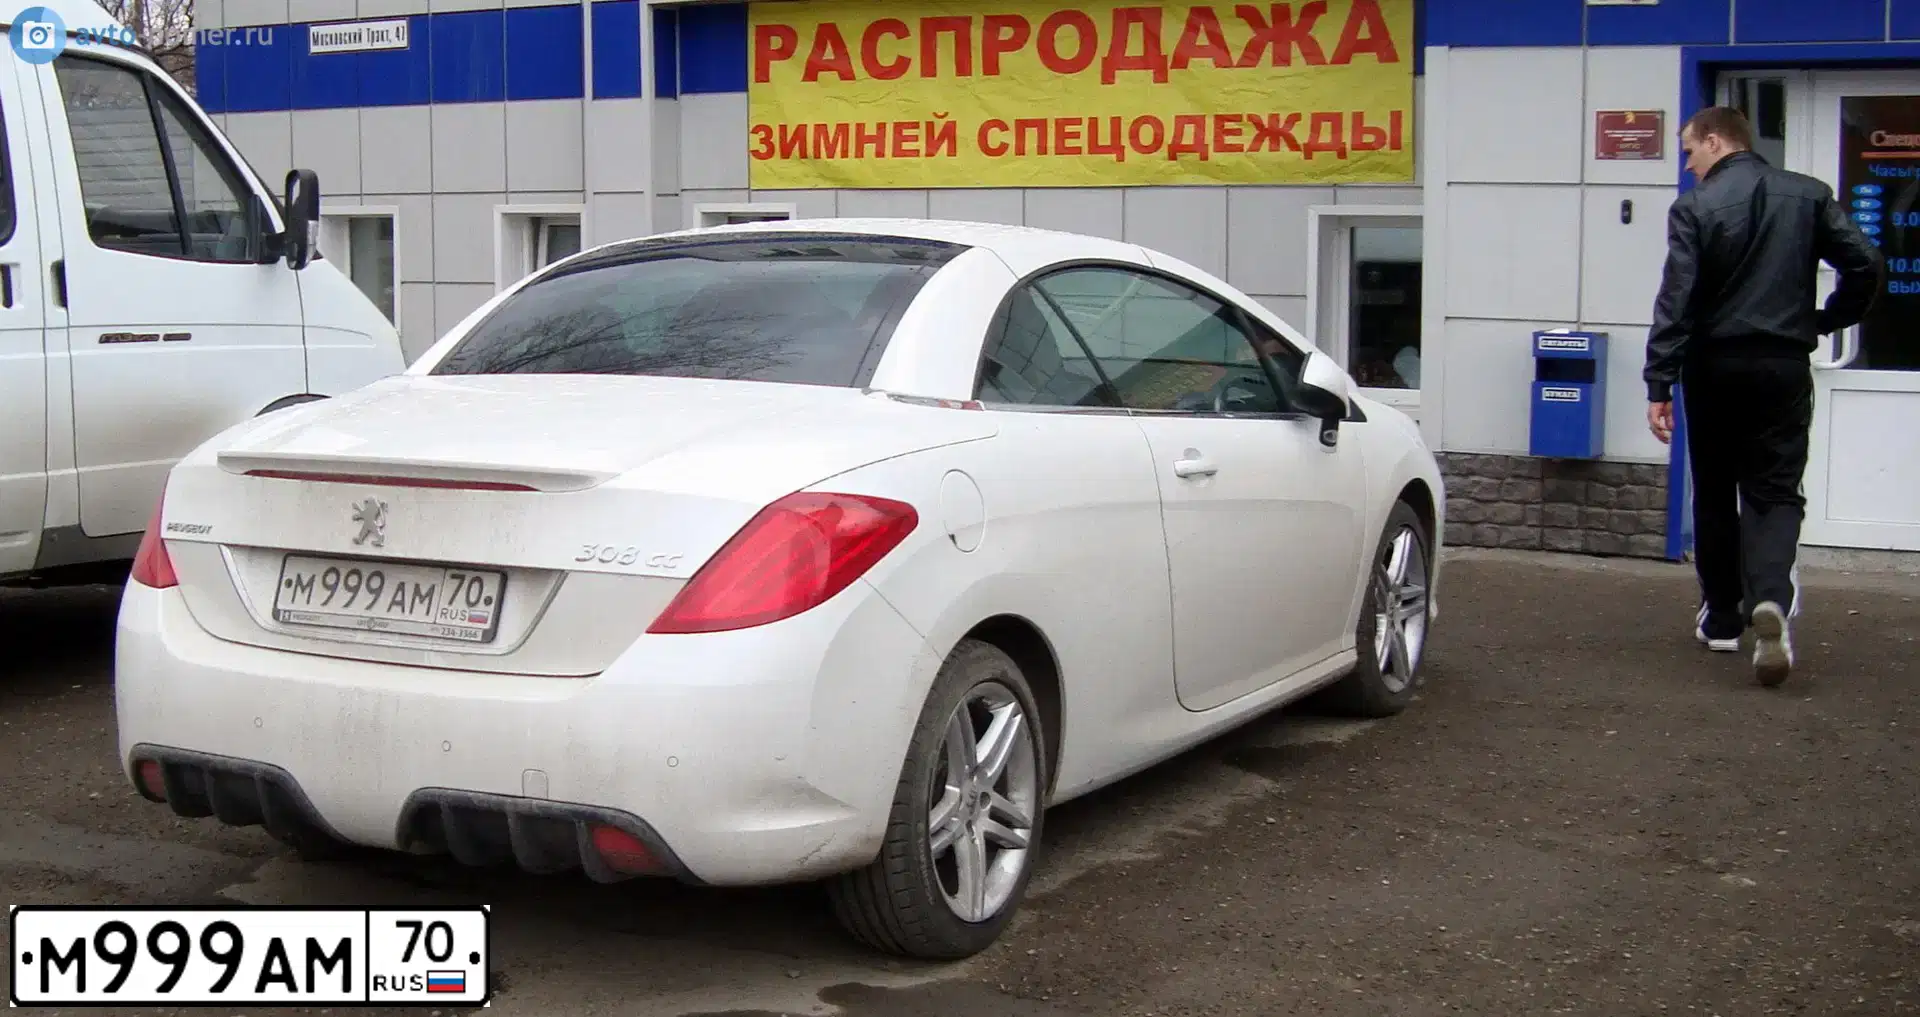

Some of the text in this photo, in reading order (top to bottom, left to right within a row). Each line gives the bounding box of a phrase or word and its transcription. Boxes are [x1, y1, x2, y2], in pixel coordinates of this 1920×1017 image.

[312, 28, 363, 46] Московский
[754, 0, 1399, 85] РАСПРОДАЖА
[750, 110, 1403, 162] ЗИМНЕЙ СПЕЦОДЕЖДЫ
[166, 521, 213, 535] PEUGEOT
[574, 543, 640, 567] 308
[448, 573, 484, 608] 70
[440, 607, 467, 622] RUS
